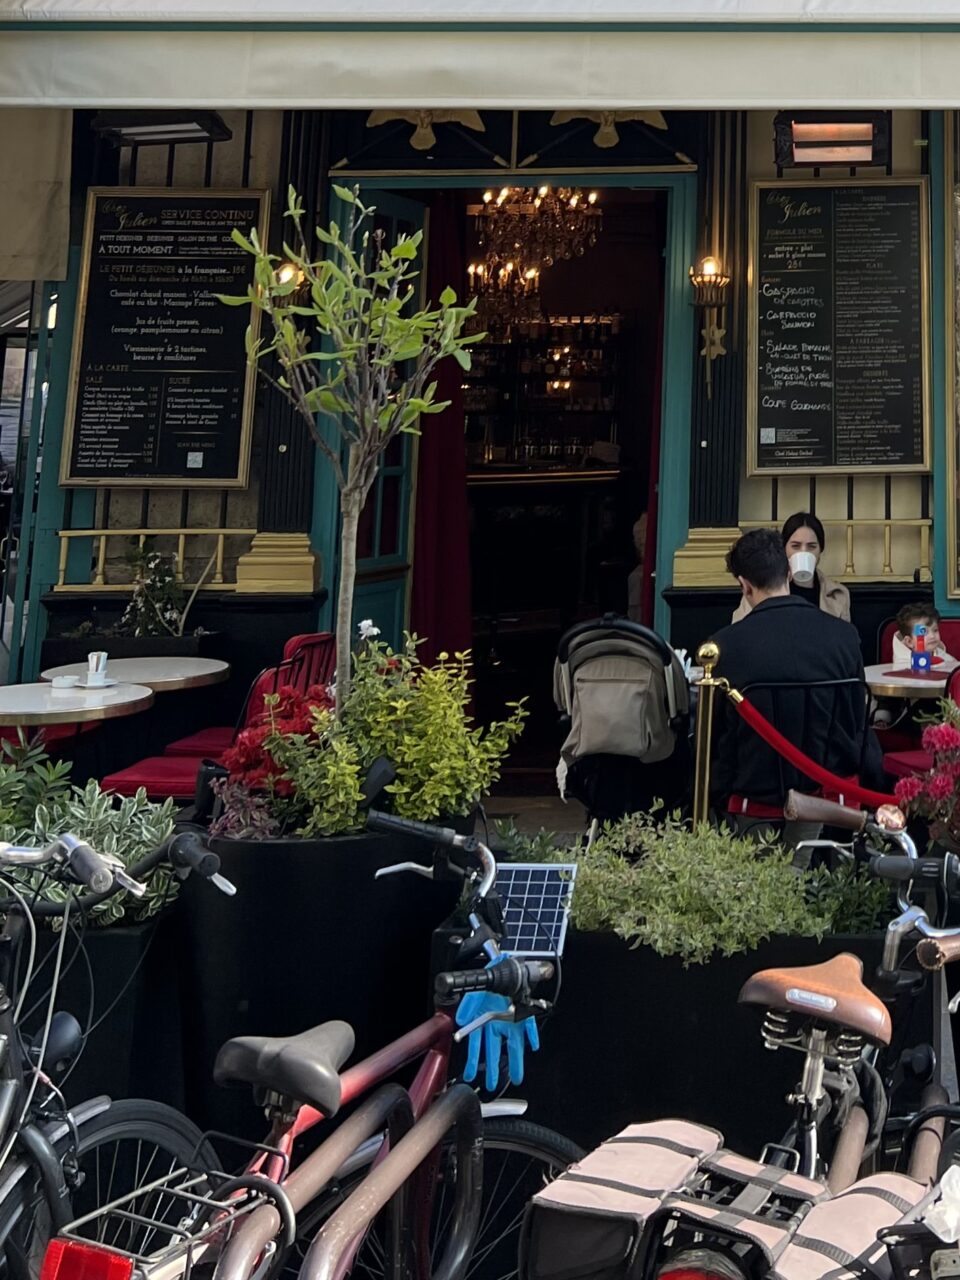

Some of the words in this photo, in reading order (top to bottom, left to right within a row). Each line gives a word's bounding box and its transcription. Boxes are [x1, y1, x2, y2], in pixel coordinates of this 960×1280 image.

[160, 210, 202, 220] SERVICE
[204, 210, 254, 220] CONTINU
[777, 201, 822, 224] Julien
[118, 211, 158, 230] Julien
[99, 245, 105, 254] À
[107, 245, 130, 254] TOUT
[133, 245, 174, 254] MOMENT
[100, 265, 110, 273] LE
[112, 265, 134, 273] PETIT
[136, 265, 176, 273] DÉJEUNER
[178, 265, 183, 273] à
[185, 265, 192, 273] la
[110, 290, 138, 298] Chocolat
[140, 290, 161, 298] chaud
[763, 284, 815, 299] GASPACHO
[767, 310, 816, 320] CARPACCIO
[140, 326, 189, 334] pamplemousse
[781, 320, 815, 330] SAUMON
[767, 340, 797, 354] SALADE
[762, 396, 787, 408] COUPE
